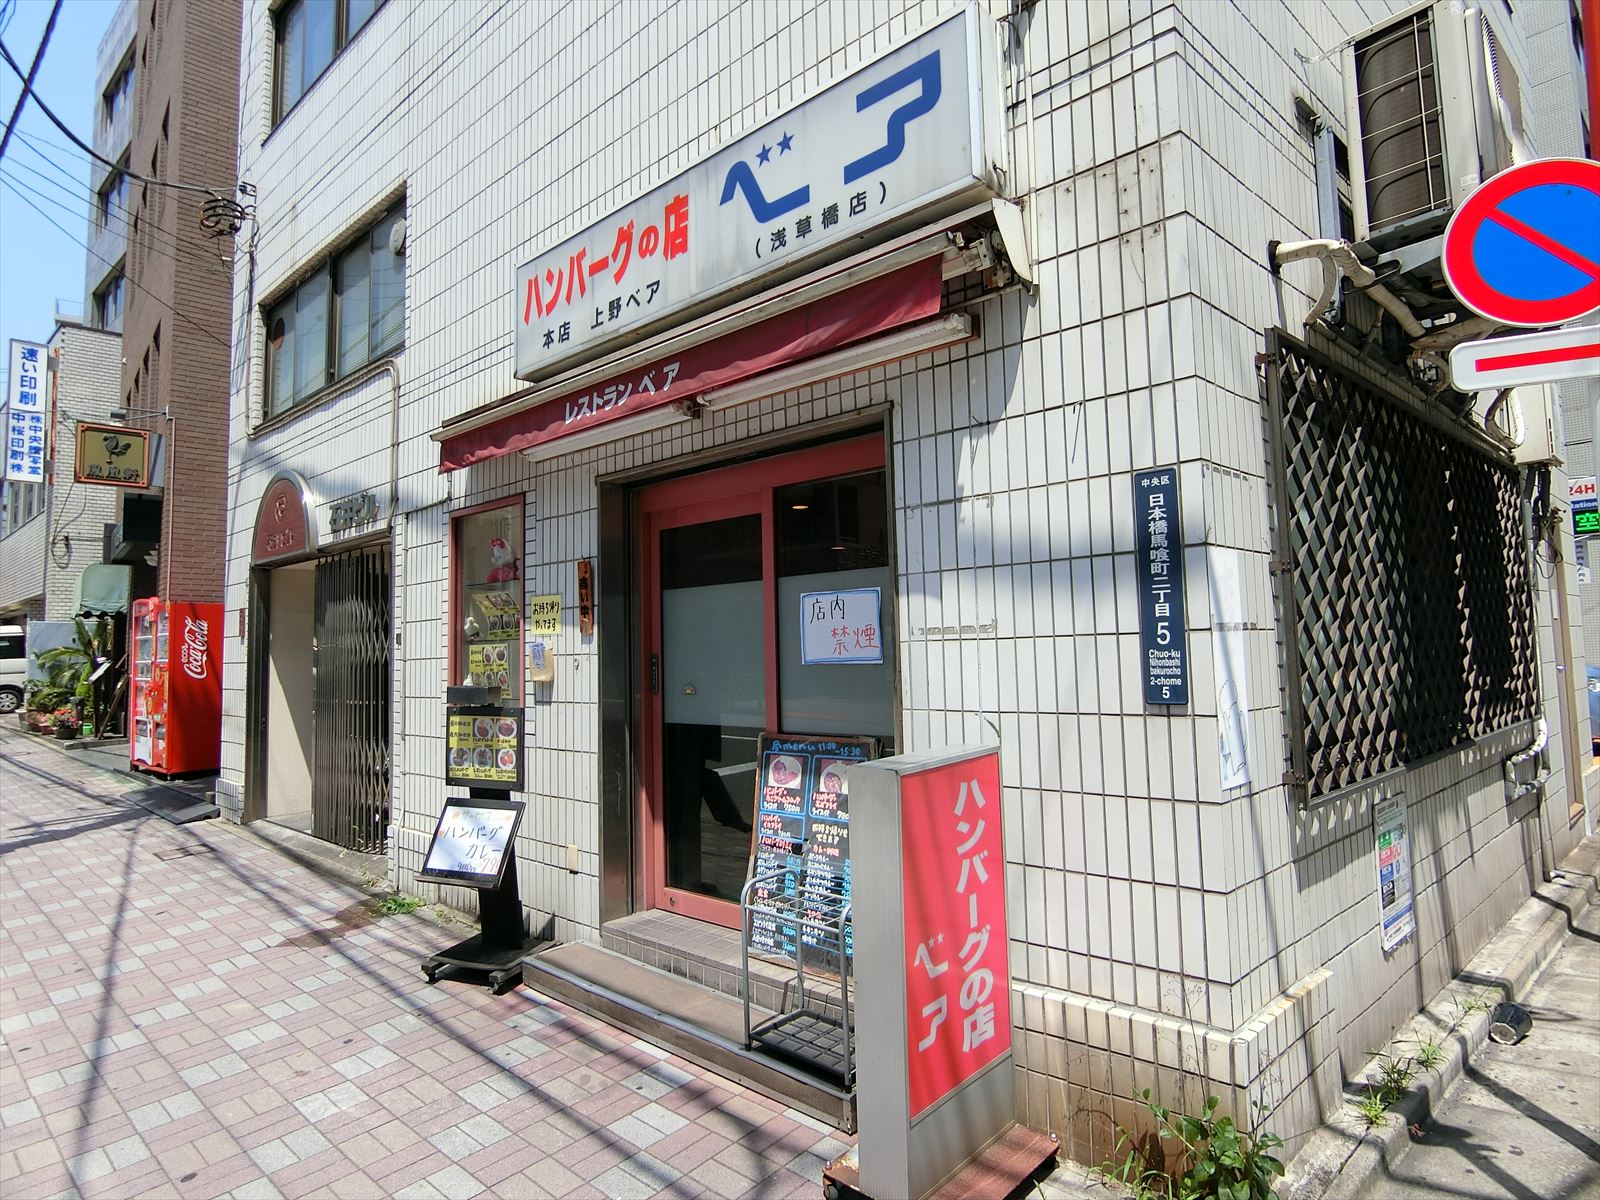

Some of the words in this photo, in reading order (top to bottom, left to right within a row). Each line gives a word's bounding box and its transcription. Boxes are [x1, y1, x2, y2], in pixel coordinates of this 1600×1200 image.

[719, 48, 941, 224] ベア
[524, 193, 689, 326] ハンバーグの店
[542, 321, 571, 349] 本店
[590, 279, 661, 330] 上野ベア
[19, 346, 39, 407] 速い印刷
[1141, 475, 1170, 488] 中央区
[1148, 493, 1171, 617] 日本橋馬喰町二丁目
[810, 594, 845, 624] 店内
[831, 623, 879, 655] 禁煙
[1156, 621, 1171, 645] 5
[1149, 649, 1180, 658] Chuo-ku
[1149, 658, 1181, 667] Nihonbashi
[1150, 666, 1181, 676] bakurocho
[1150, 676, 1182, 686] 2-chome
[1161, 686, 1170, 699] 5
[444, 826, 503, 841] ハンバーグ
[465, 844, 502, 860] カレー
[953, 778, 996, 1054] ハンバーグの店
[913, 931, 949, 1053] ベア
